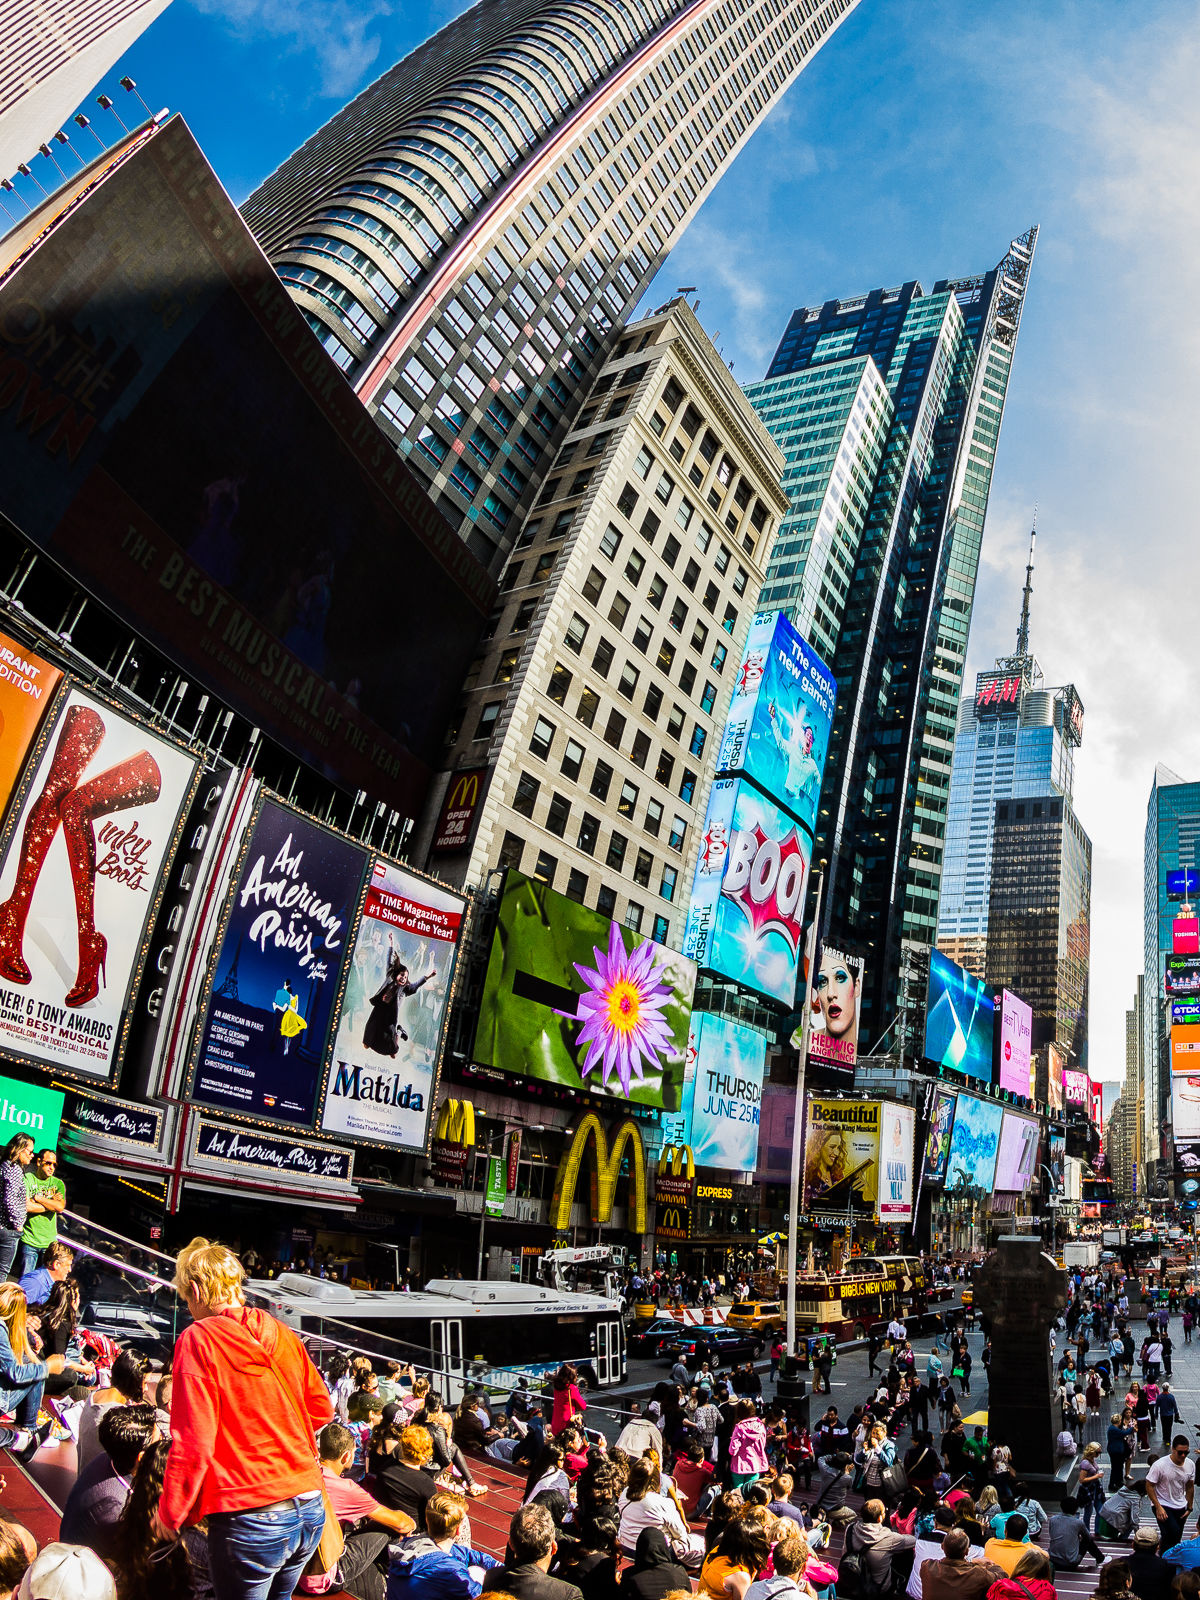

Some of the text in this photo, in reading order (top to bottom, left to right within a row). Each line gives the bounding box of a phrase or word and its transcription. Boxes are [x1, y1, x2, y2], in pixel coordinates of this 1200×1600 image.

[120, 524, 158, 571] THE
[159, 550, 229, 629] BEST
[222, 615, 328, 717] MUSICAL
[344, 720, 369, 753] THE
[370, 746, 400, 780] YEAR
[791, 640, 808, 670] The
[779, 650, 828, 711] new game
[977, 678, 1022, 706] H&M
[447, 810, 472, 820] OPEN
[445, 820, 466, 835] 24
[437, 836, 467, 846] HOURS
[269, 832, 304, 879] An
[95, 852, 149, 892] Boots
[240, 855, 341, 948] American
[380, 893, 448, 925] TIME Magazine's
[369, 904, 453, 940] #1 Show of the Year!
[249, 910, 315, 966] Paris
[821, 945, 864, 969] DARREN CRISS
[26, 999, 113, 1040] 6 TONY AWARDS
[221, 1012, 245, 1025] AMERICAN
[250, 1021, 264, 1032] PARIS
[26, 1018, 56, 1034] BEST
[59, 1028, 108, 1051] MUSICAL
[49, 1036, 68, 1049] TICKETS
[68, 1042, 78, 1053] CALL
[811, 1032, 855, 1054] HEDWIG
[220, 1048, 234, 1058] LUCAS
[810, 1044, 854, 1064] ANGRY INCH
[330, 1060, 424, 1112] Matilda
[1067, 1087, 1088, 1102] DATA
[372, 1106, 392, 1114] MUSICAL
[703, 1096, 752, 1122] JUNE 25
[812, 1104, 878, 1123] Beautiful
[114, 1113, 137, 1135] Paris
[842, 1124, 856, 1133] King
[206, 1132, 318, 1172] An American Paris
[434, 1146, 466, 1160] McDonald's
[494, 1160, 502, 1190] TASTE
[656, 1179, 692, 1189] McDonald's
[697, 1185, 732, 1200] EXPRESS
[815, 1216, 856, 1228] LUGGAGE
[866, 1282, 880, 1294] NEW
[880, 1280, 897, 1292] YORK
